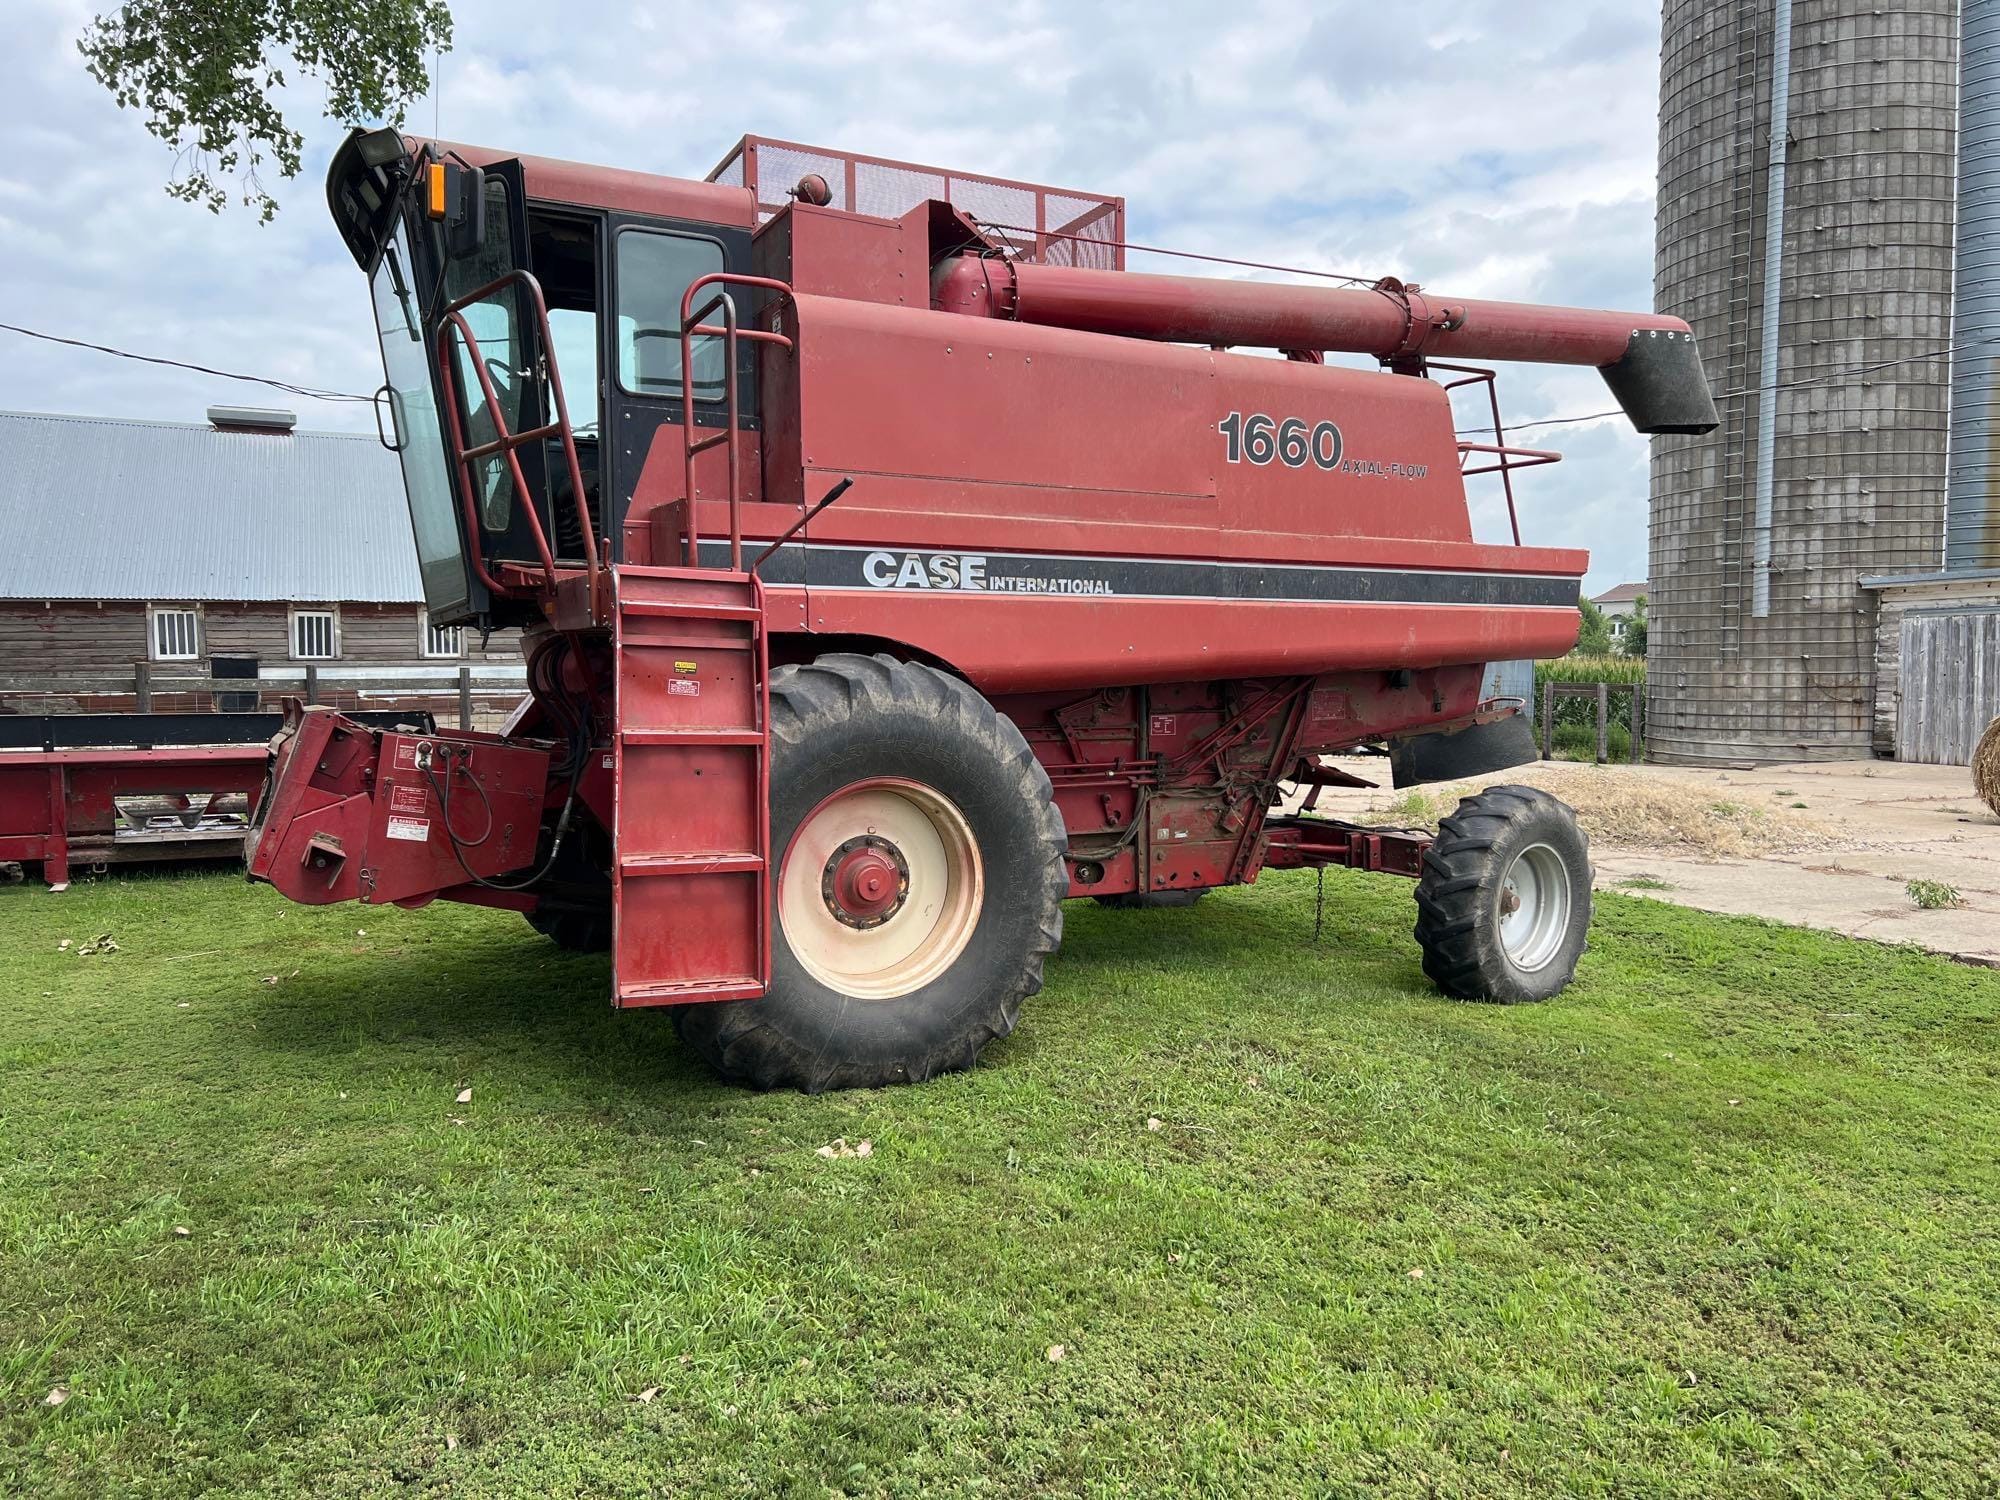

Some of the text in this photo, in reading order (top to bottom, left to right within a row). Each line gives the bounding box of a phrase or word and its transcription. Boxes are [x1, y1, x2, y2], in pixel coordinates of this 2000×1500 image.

[1219, 411, 1428, 478] 1660 AXIAL-FLOW
[863, 552, 1114, 594] CASE INTERNATIONAL
